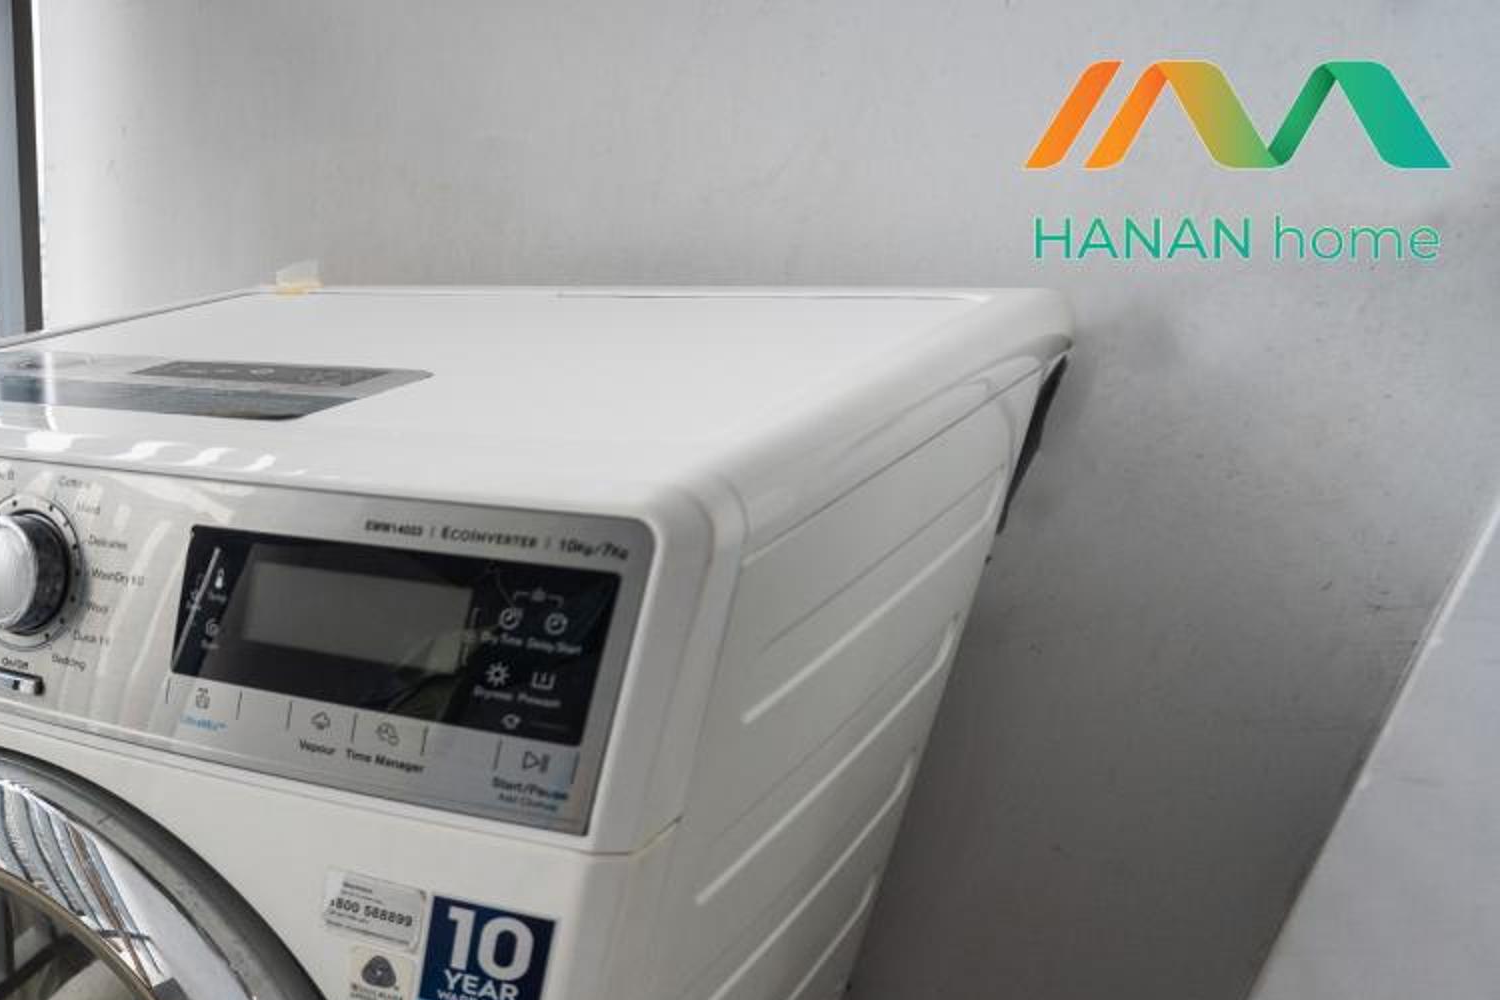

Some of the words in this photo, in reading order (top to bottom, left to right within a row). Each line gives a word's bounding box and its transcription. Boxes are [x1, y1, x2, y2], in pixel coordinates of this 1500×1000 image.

[299, 739, 336, 755] Vapour
[345, 748, 372, 763] Time
[375, 755, 424, 774] Manager
[448, 905, 535, 982] 10
